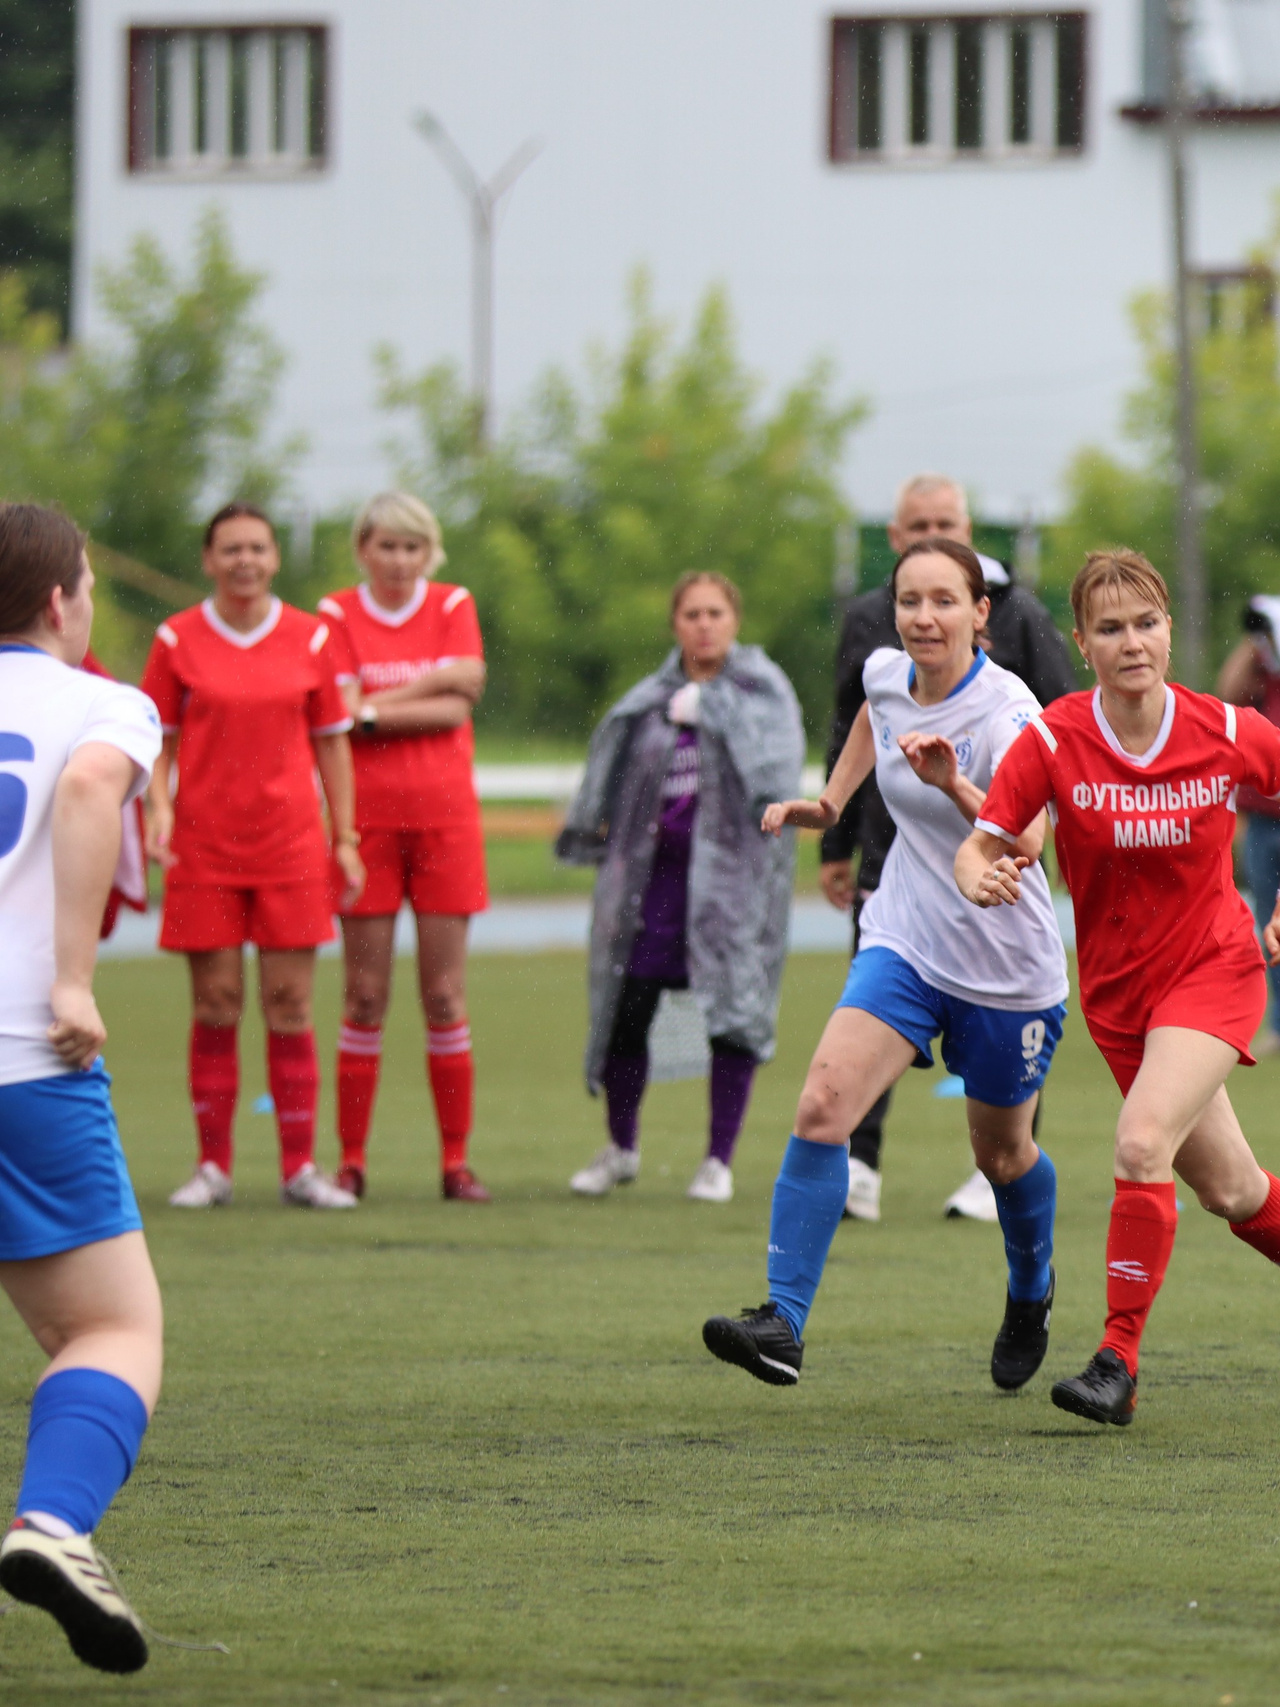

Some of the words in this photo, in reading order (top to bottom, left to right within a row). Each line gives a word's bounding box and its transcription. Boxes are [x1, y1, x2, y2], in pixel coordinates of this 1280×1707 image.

[1072, 774, 1231, 812] ФУТБОЛЬНЫЕ
[1114, 816, 1191, 849] МАМЫ
[1021, 1019, 1046, 1060] 9
